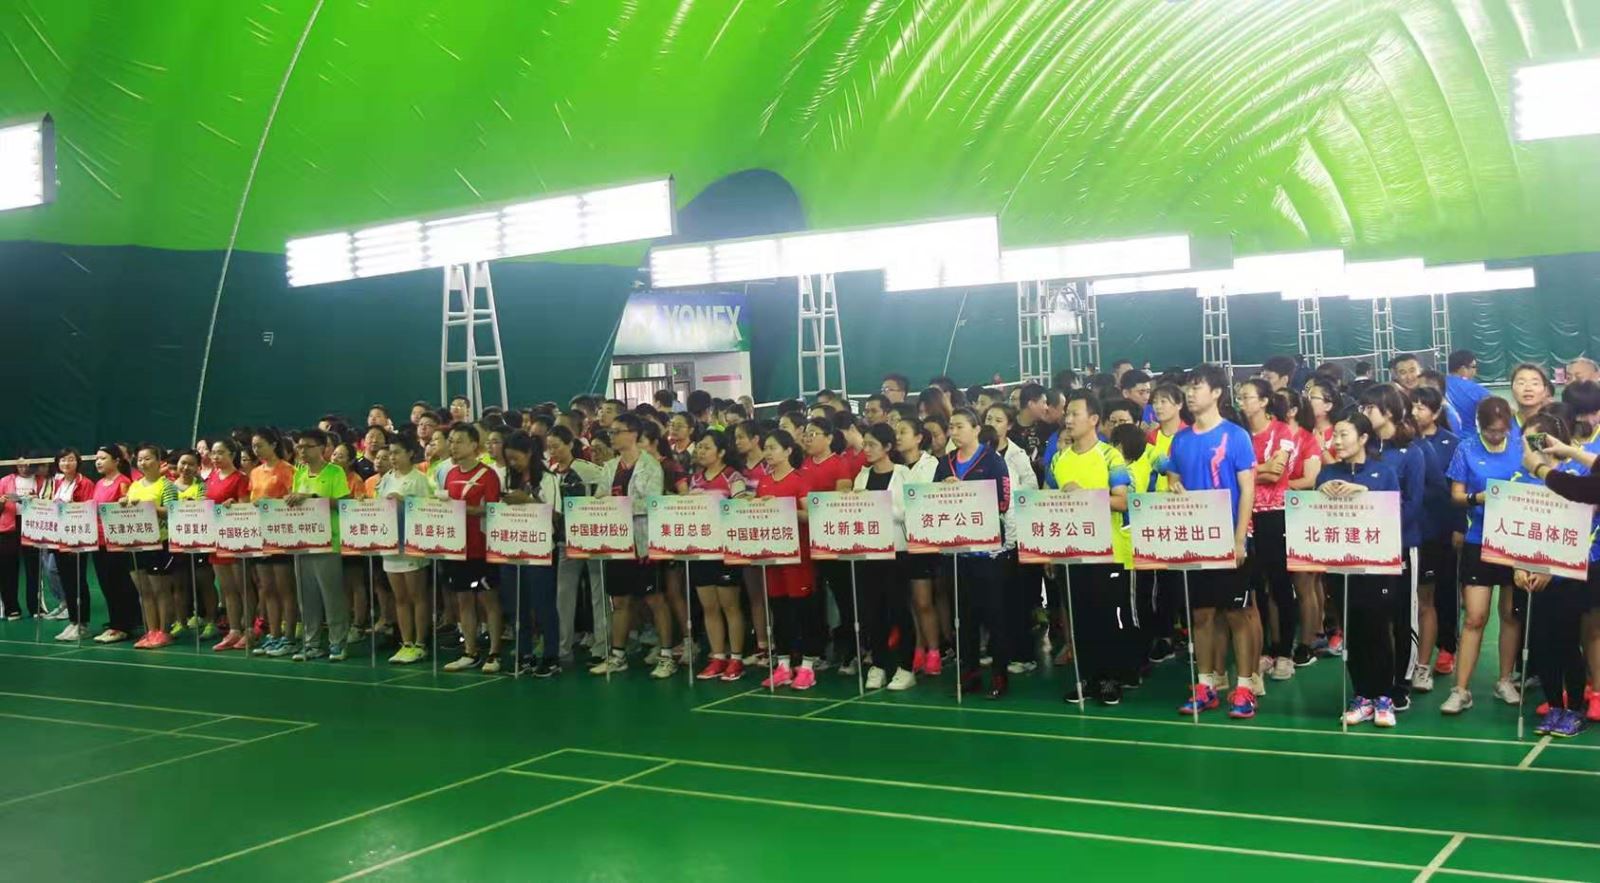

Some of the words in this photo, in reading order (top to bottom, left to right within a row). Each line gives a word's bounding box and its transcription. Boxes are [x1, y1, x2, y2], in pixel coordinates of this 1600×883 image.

[663, 304, 742, 341] YONEX
[921, 512, 983, 528] 资产公司
[64, 524, 92, 535] 中材水泥
[109, 523, 153, 534] 天津水泥院
[176, 524, 207, 534] 中国复材
[350, 524, 388, 535] 地勘中心
[415, 524, 455, 538] 凯盛科技
[569, 524, 630, 538] 中国建材股份
[661, 524, 711, 536] 集团总部
[727, 527, 793, 541] 中国建材总院
[824, 521, 879, 535] 北新集团
[1032, 522, 1095, 537] 财务公司
[1142, 525, 1220, 542] 中材进出口
[1305, 526, 1380, 544] 北新建材
[1494, 517, 1579, 547] 人工晶体院
[489, 530, 547, 543] 中建材进出口
